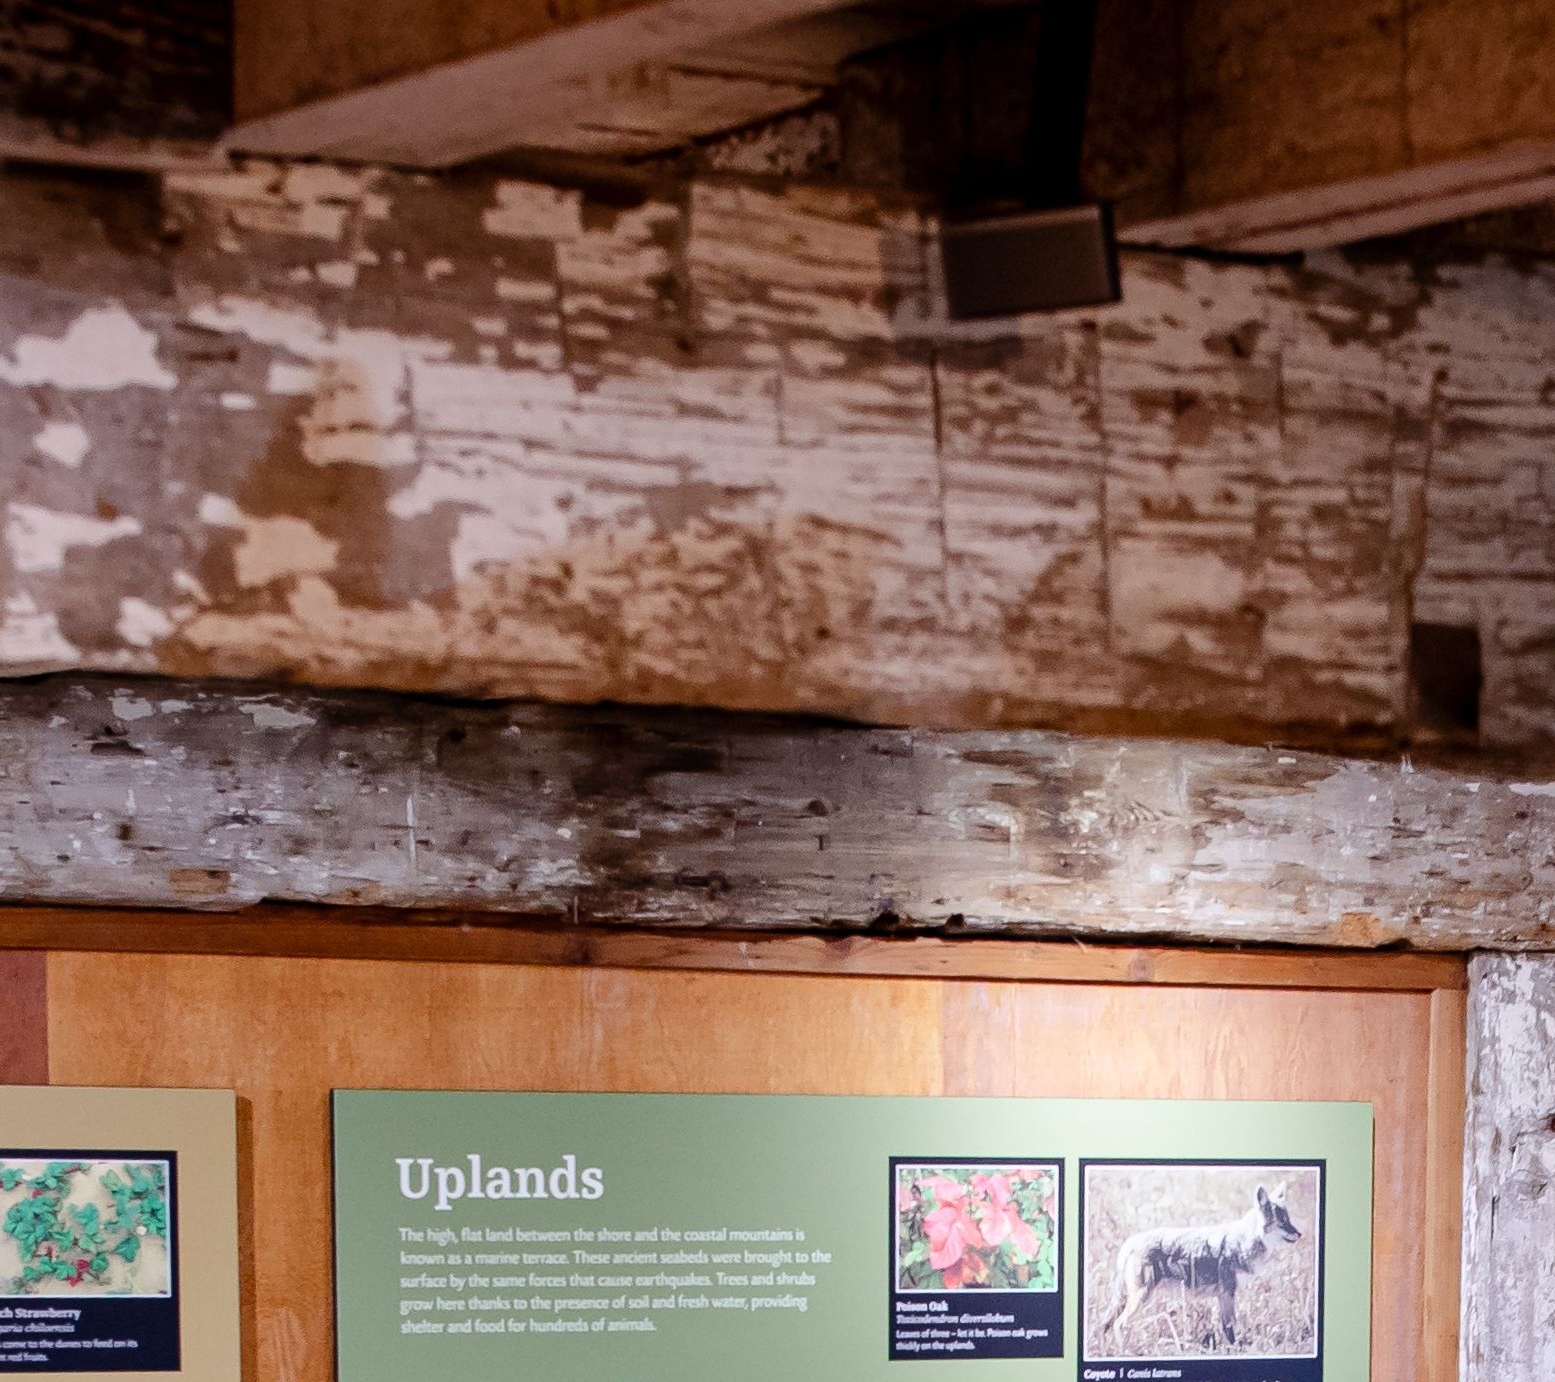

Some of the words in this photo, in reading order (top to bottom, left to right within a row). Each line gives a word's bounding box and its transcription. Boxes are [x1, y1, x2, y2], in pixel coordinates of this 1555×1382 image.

[395, 1153, 605, 1211] Uplands
[398, 1227, 424, 1242] The
[426, 1227, 459, 1246] high,
[461, 1227, 483, 1242] flat
[485, 1227, 514, 1242] land
[516, 1227, 571, 1242] between
[573, 1227, 595, 1242] the
[597, 1227, 632, 1242] shore
[634, 1227, 658, 1242] and
[660, 1227, 681, 1242] the
[683, 1227, 727, 1242] coastal
[729, 1228, 793, 1242] mountains
[795, 1228, 805, 1242] is
[400, 1251, 446, 1265] known
[447, 1254, 462, 1265] as
[464, 1254, 473, 1265] a
[474, 1251, 520, 1265] marine
[522, 1253, 570, 1264] terrace.
[572, 1250, 611, 1264] These
[612, 1251, 658, 1264] ancient
[660, 1249, 709, 1264] seabeds
[711, 1253, 742, 1264] were
[744, 1249, 792, 1268] brought
[795, 1252, 809, 1263] to
[811, 1249, 832, 1263] the
[400, 1272, 447, 1288] surface
[449, 1273, 467, 1292] by
[468, 1273, 490, 1288] the
[492, 1276, 526, 1287] same
[528, 1272, 567, 1287] forces
[569, 1272, 596, 1287] that
[597, 1276, 633, 1287] cause
[635, 1272, 713, 1290] earthquakes.
[716, 1272, 749, 1286] Trees
[750, 1271, 774, 1286] and
[776, 1271, 816, 1285] shrubs
[15, 1308, 81, 1320] Strawberry
[399, 1300, 434, 1316] grow
[436, 1296, 466, 1311] here
[468, 1296, 511, 1310] thanks
[513, 1298, 528, 1310] to
[530, 1296, 552, 1310] the
[554, 1299, 610, 1314] presence
[611, 1294, 627, 1309] of
[628, 1294, 650, 1309] soil
[652, 1294, 675, 1309] and
[677, 1294, 709, 1308] fresh
[710, 1297, 749, 1310] water,
[751, 1294, 808, 1312] providing
[896, 1302, 927, 1311] Poison
[929, 1301, 948, 1311] Oak
[401, 1319, 445, 1334] shelter
[447, 1319, 472, 1333] and
[474, 1318, 506, 1333] food
[507, 1318, 527, 1333] for
[529, 1318, 589, 1333] hundreds
[591, 1317, 605, 1332] of
[607, 1317, 657, 1332] animals.
